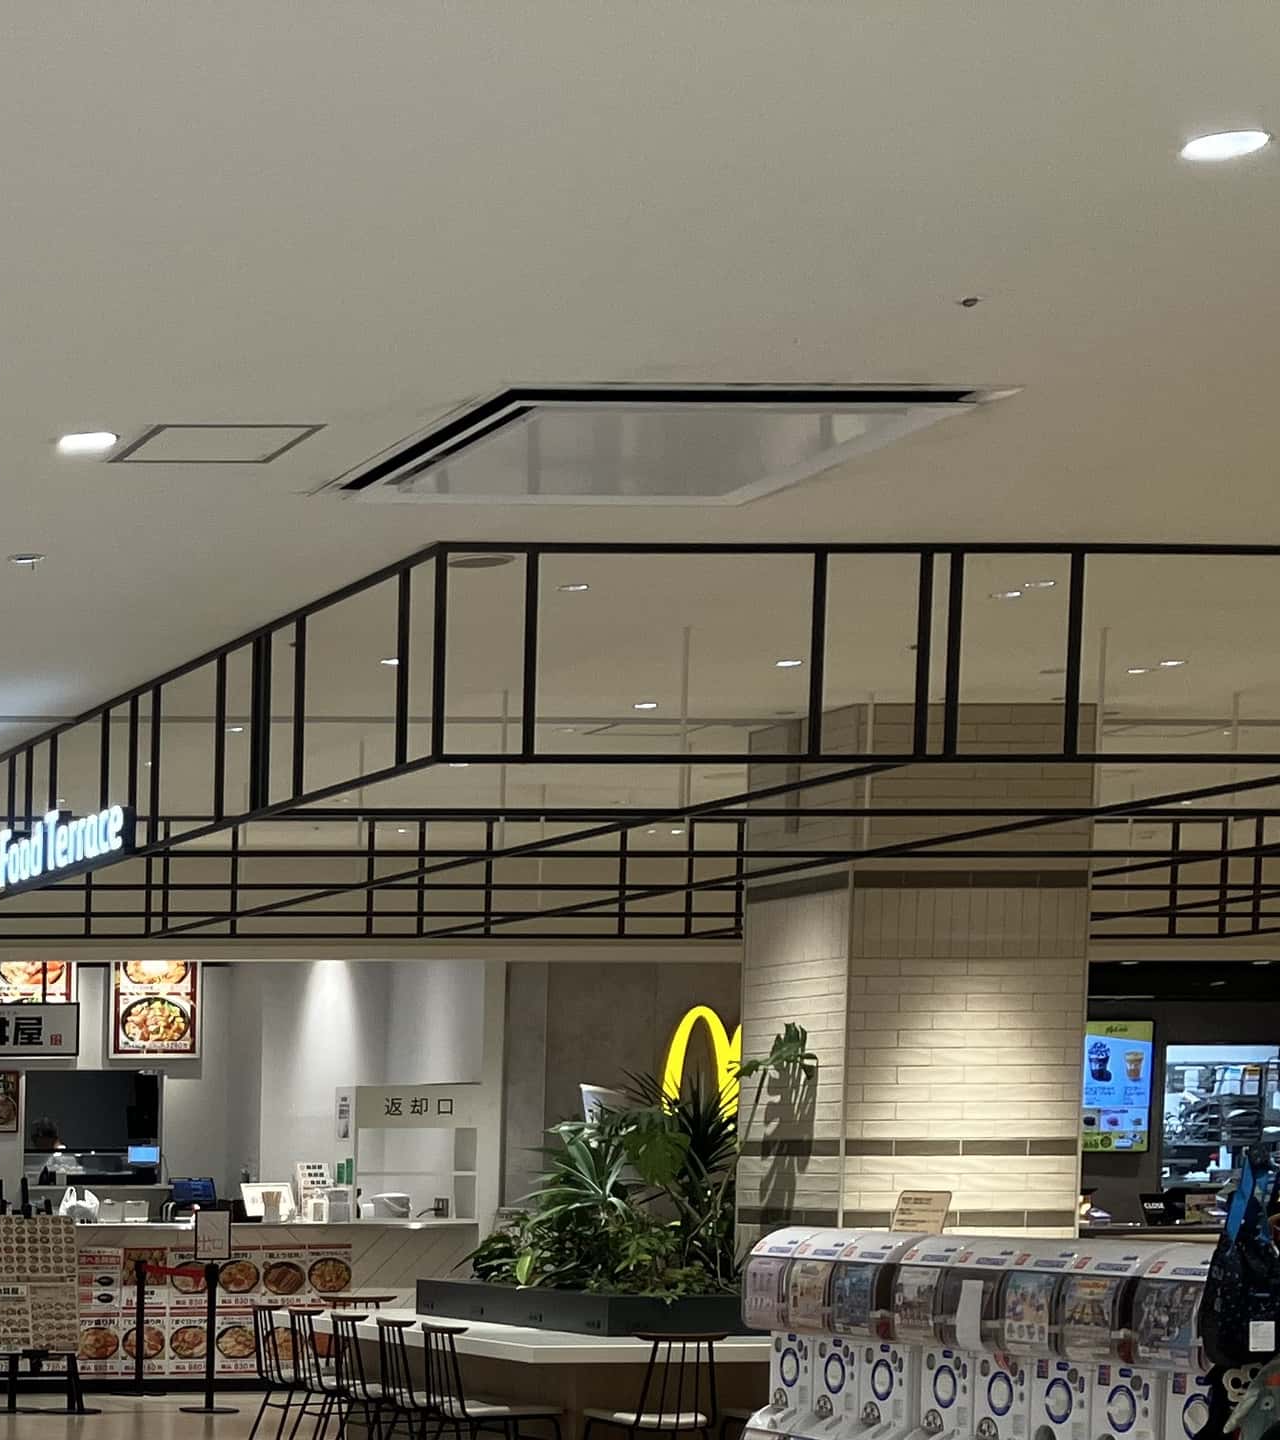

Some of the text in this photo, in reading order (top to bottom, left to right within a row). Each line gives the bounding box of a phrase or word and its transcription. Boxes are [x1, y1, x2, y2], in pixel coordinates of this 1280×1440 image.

[43, 804, 124, 871] Terrace
[384, 1096, 454, 1116] 返却口
